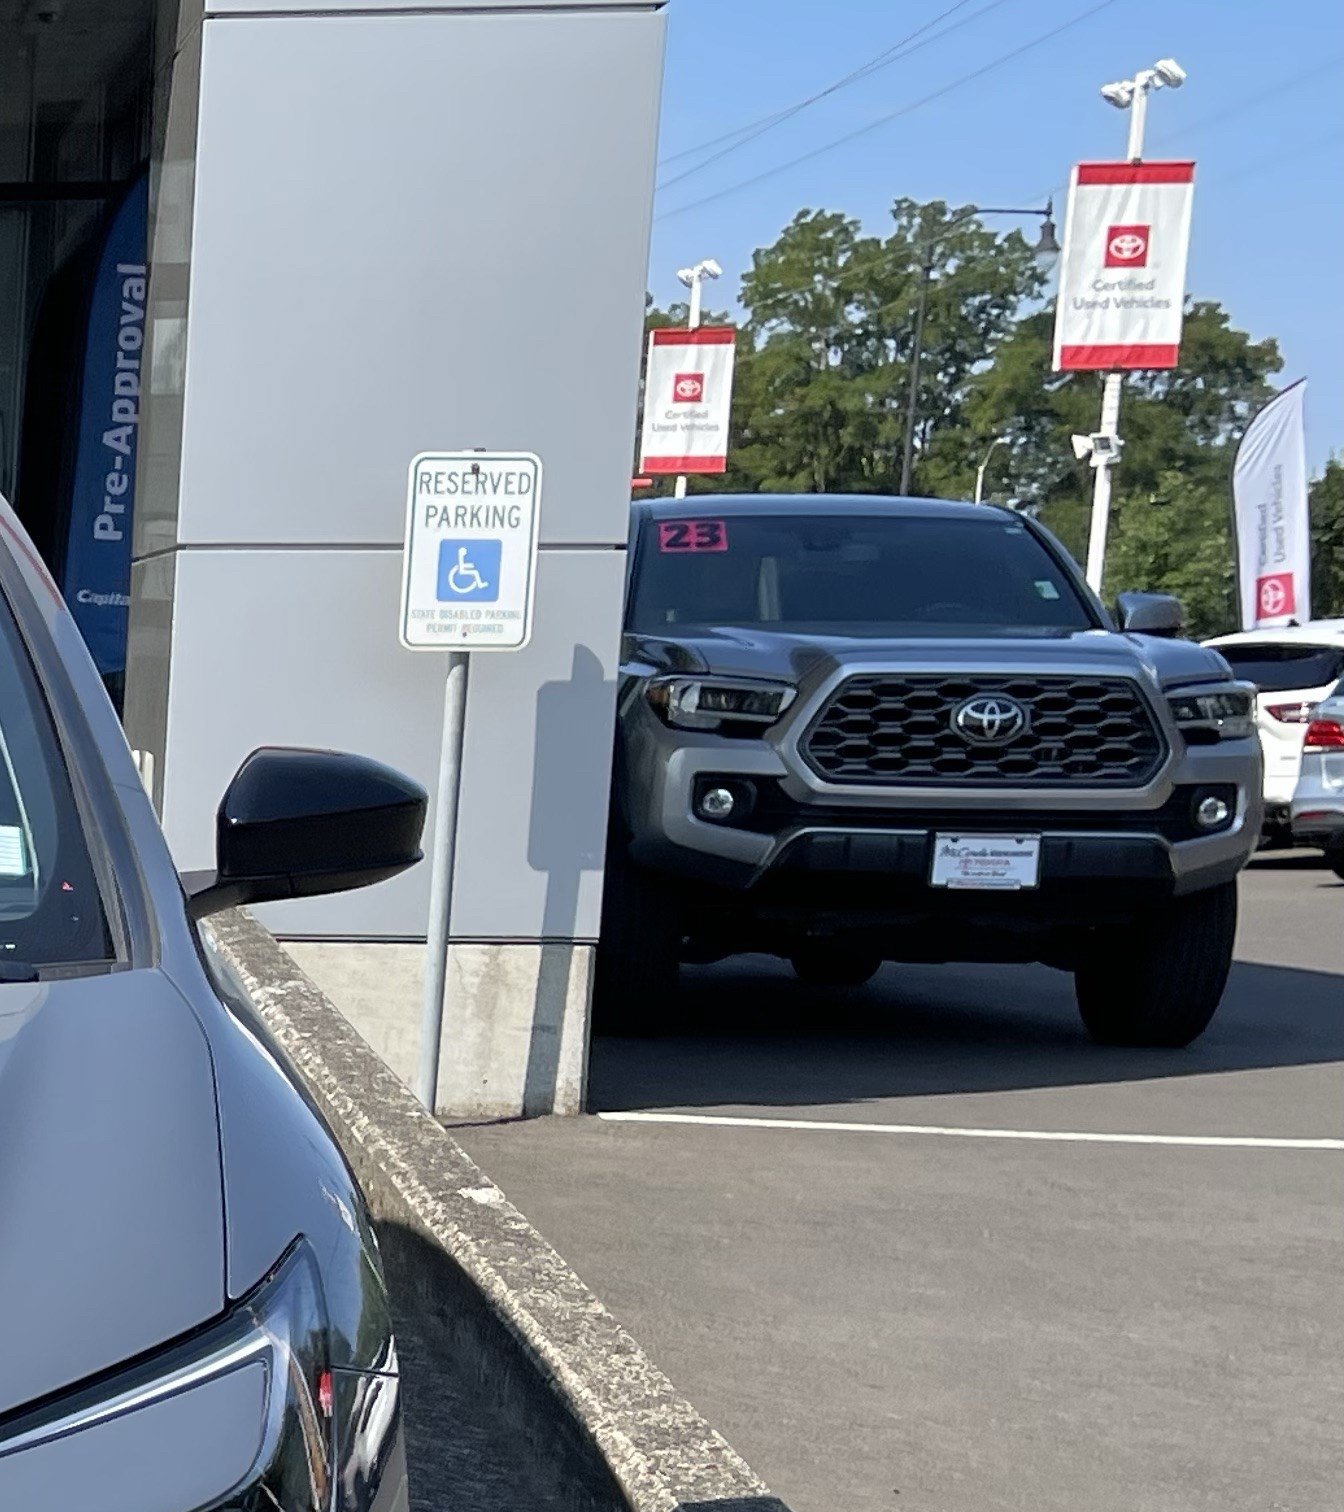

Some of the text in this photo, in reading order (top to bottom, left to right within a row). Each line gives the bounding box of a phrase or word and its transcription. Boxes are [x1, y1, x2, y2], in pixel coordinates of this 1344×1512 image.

[93, 263, 148, 541] Pre-Approval
[418, 472, 531, 496] RESERVED
[424, 505, 522, 529] PARKING
[664, 523, 721, 548] 23
